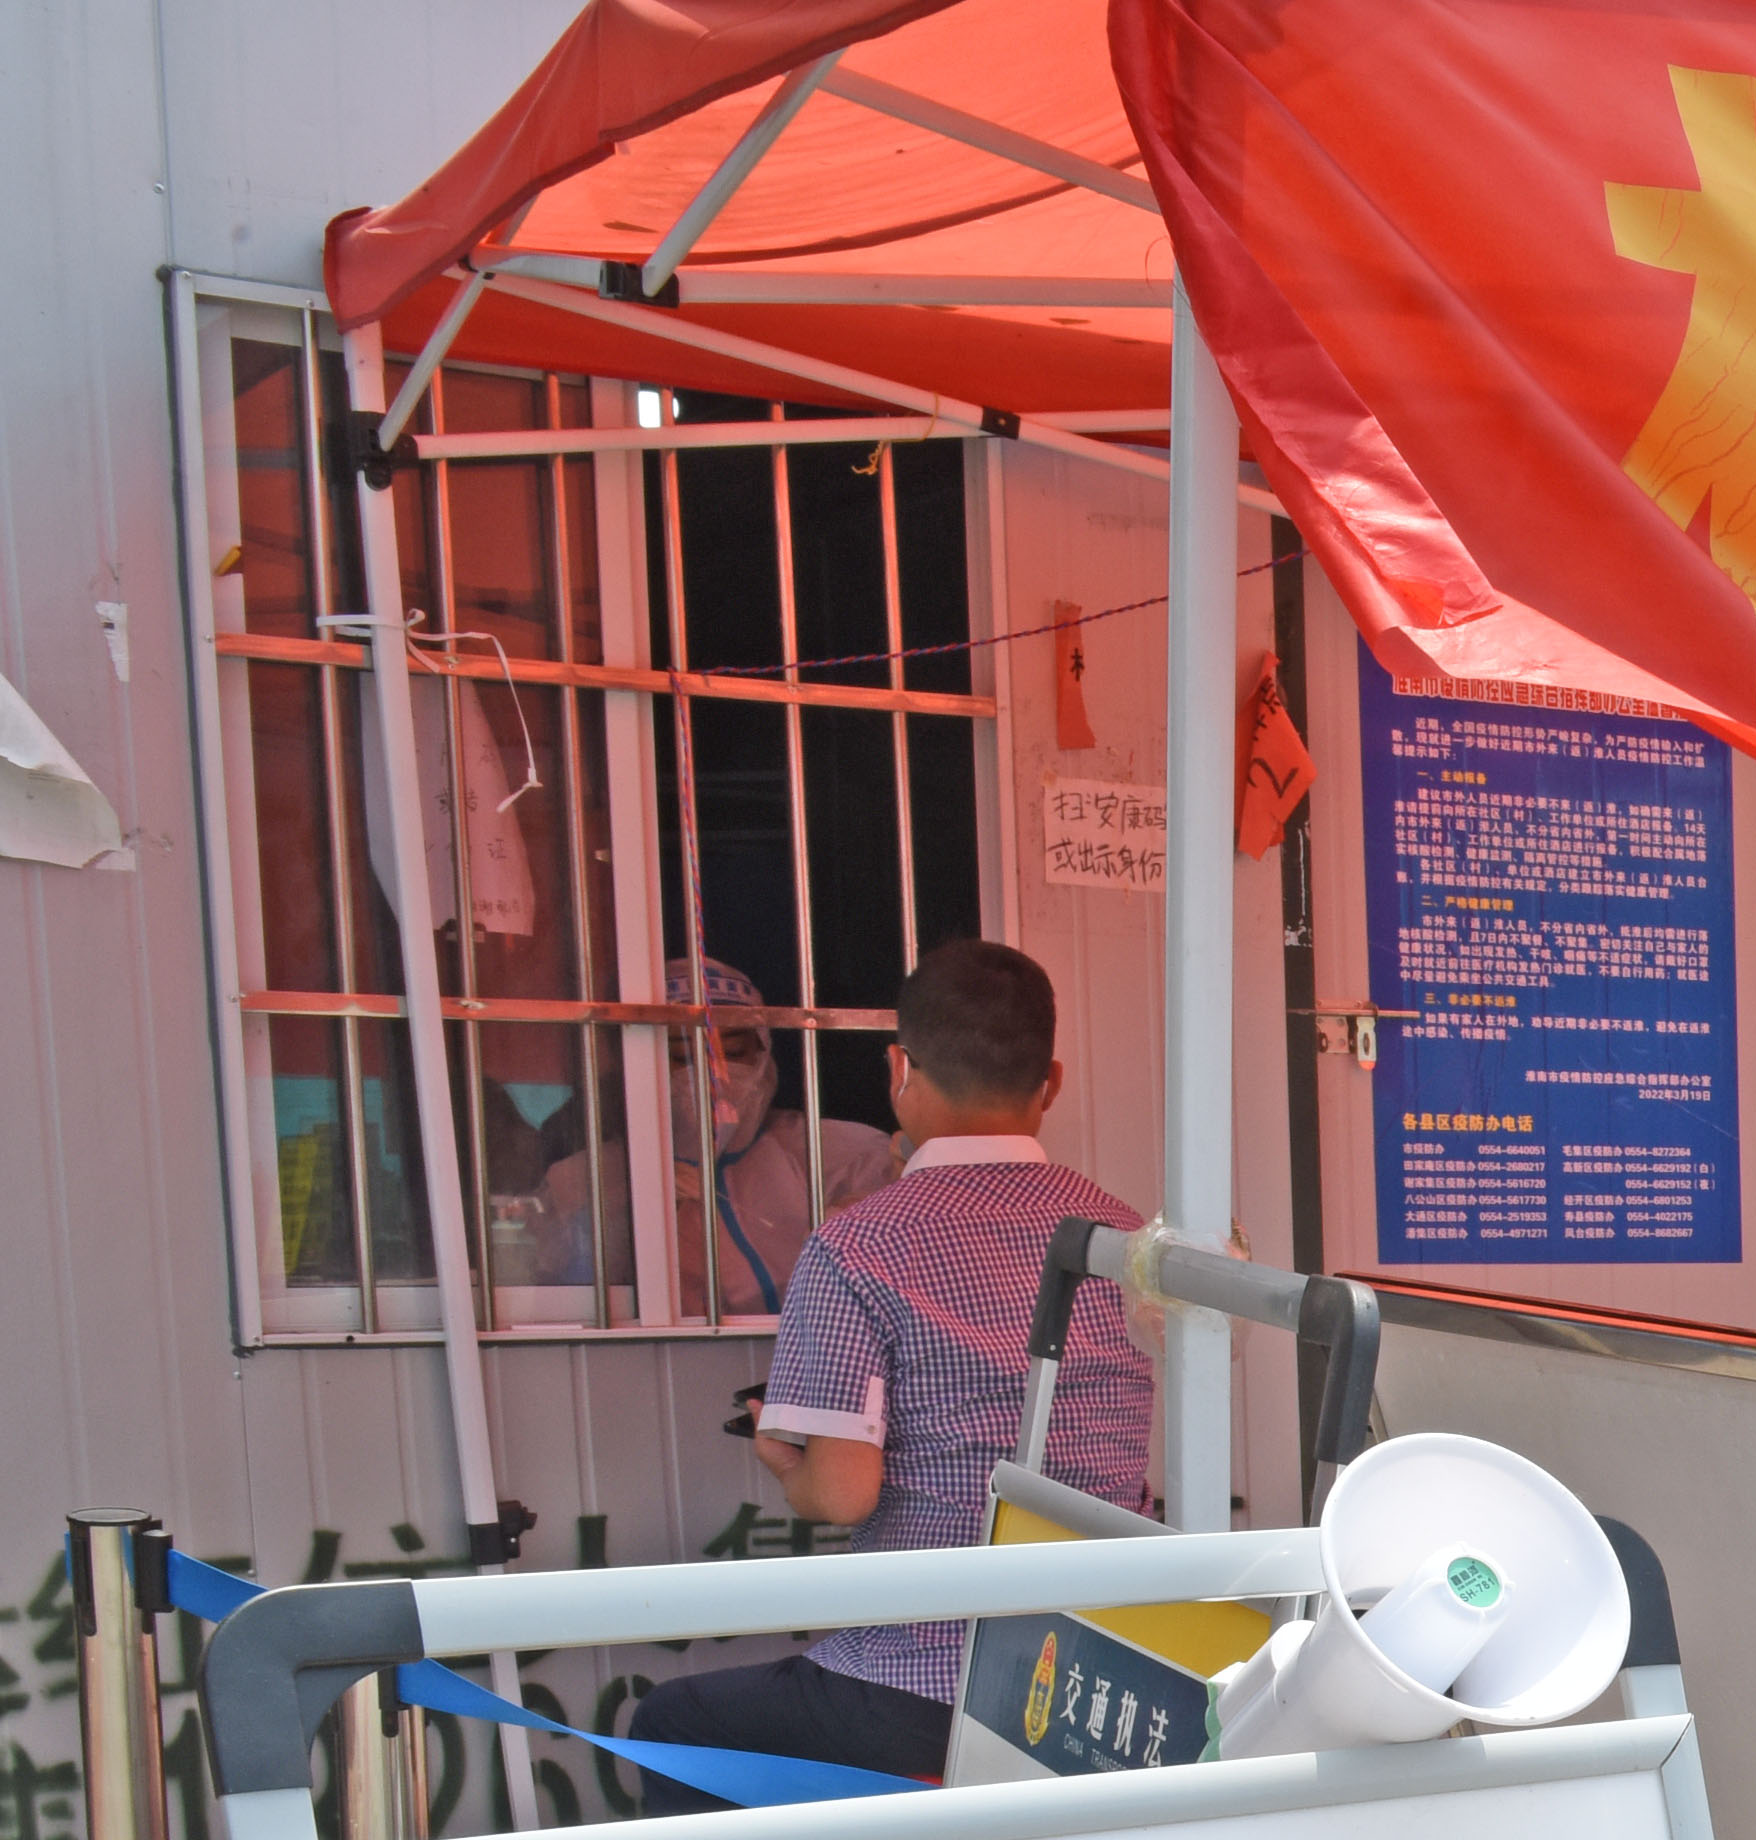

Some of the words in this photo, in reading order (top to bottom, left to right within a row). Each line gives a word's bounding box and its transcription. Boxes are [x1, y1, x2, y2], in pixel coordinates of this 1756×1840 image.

[1403, 1113, 1534, 1132] 各县区疫防办电话
[1460, 1577, 1495, 1602] SH-781
[1060, 1663, 1169, 1767] 交通执法
